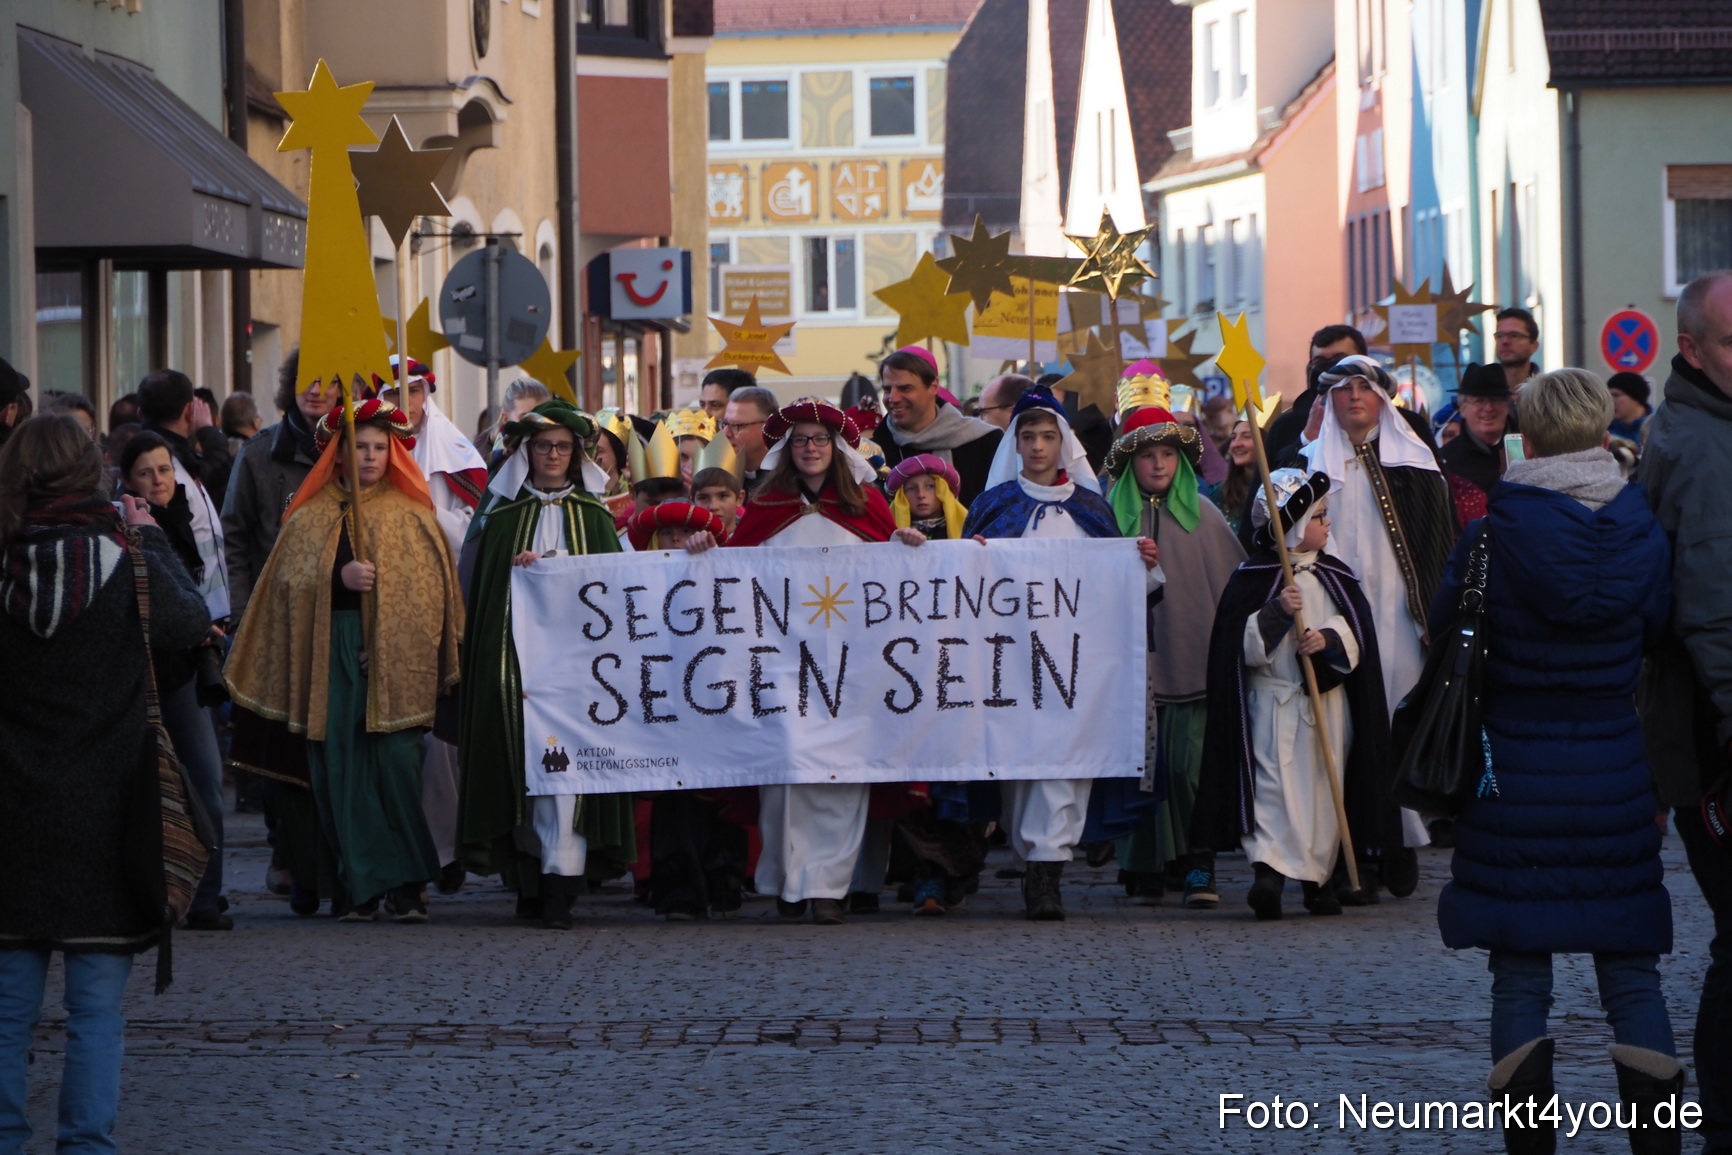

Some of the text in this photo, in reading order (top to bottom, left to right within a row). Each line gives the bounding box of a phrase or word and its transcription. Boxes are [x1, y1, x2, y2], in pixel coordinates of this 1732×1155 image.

[747, 332, 767, 341] Josef
[723, 352, 773, 362] Buckenhofen
[578, 576, 1081, 642] SEGEN BRINGEN
[588, 630, 1080, 727] SEGEN SEIN
[576, 747, 616, 758] AKTION
[576, 757, 680, 772] DREIKÖNIGSSINGEN
[1708, 802, 1725, 836] Canon
